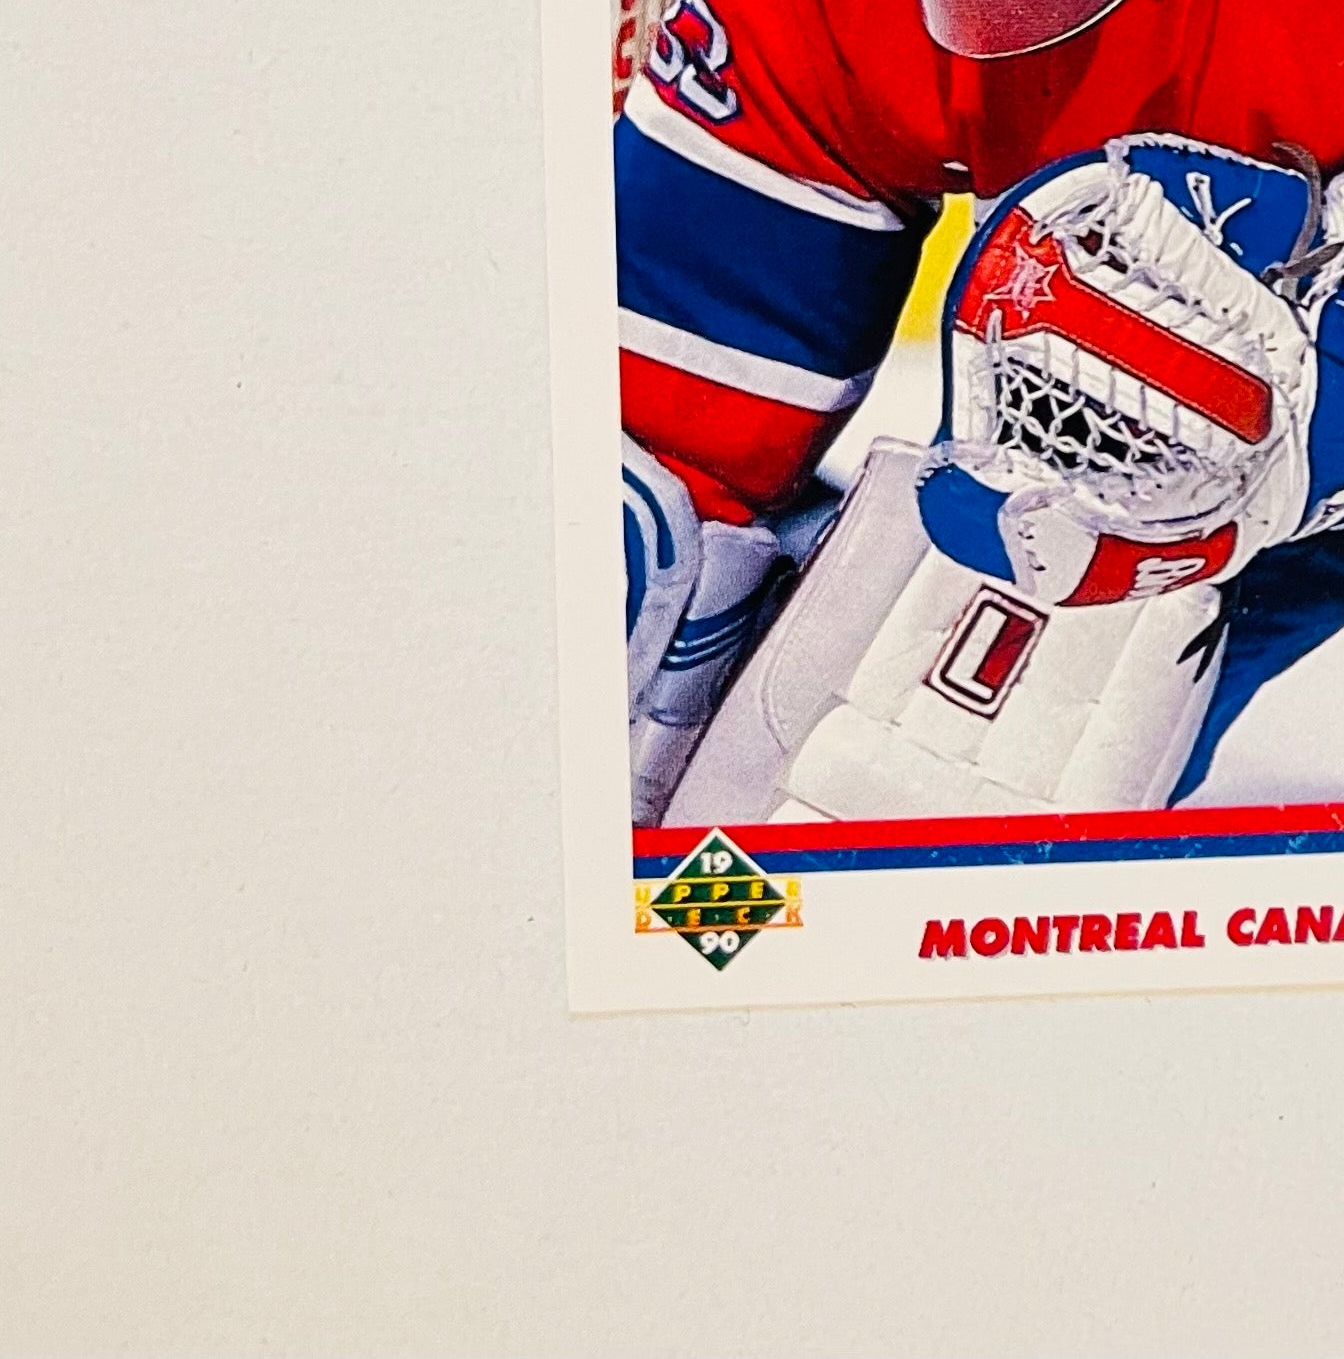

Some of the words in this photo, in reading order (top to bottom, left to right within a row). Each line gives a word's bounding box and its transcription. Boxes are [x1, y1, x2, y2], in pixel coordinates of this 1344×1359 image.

[699, 850, 734, 874] 19
[699, 930, 740, 955] 90
[919, 910, 1205, 959] MONTREAL
